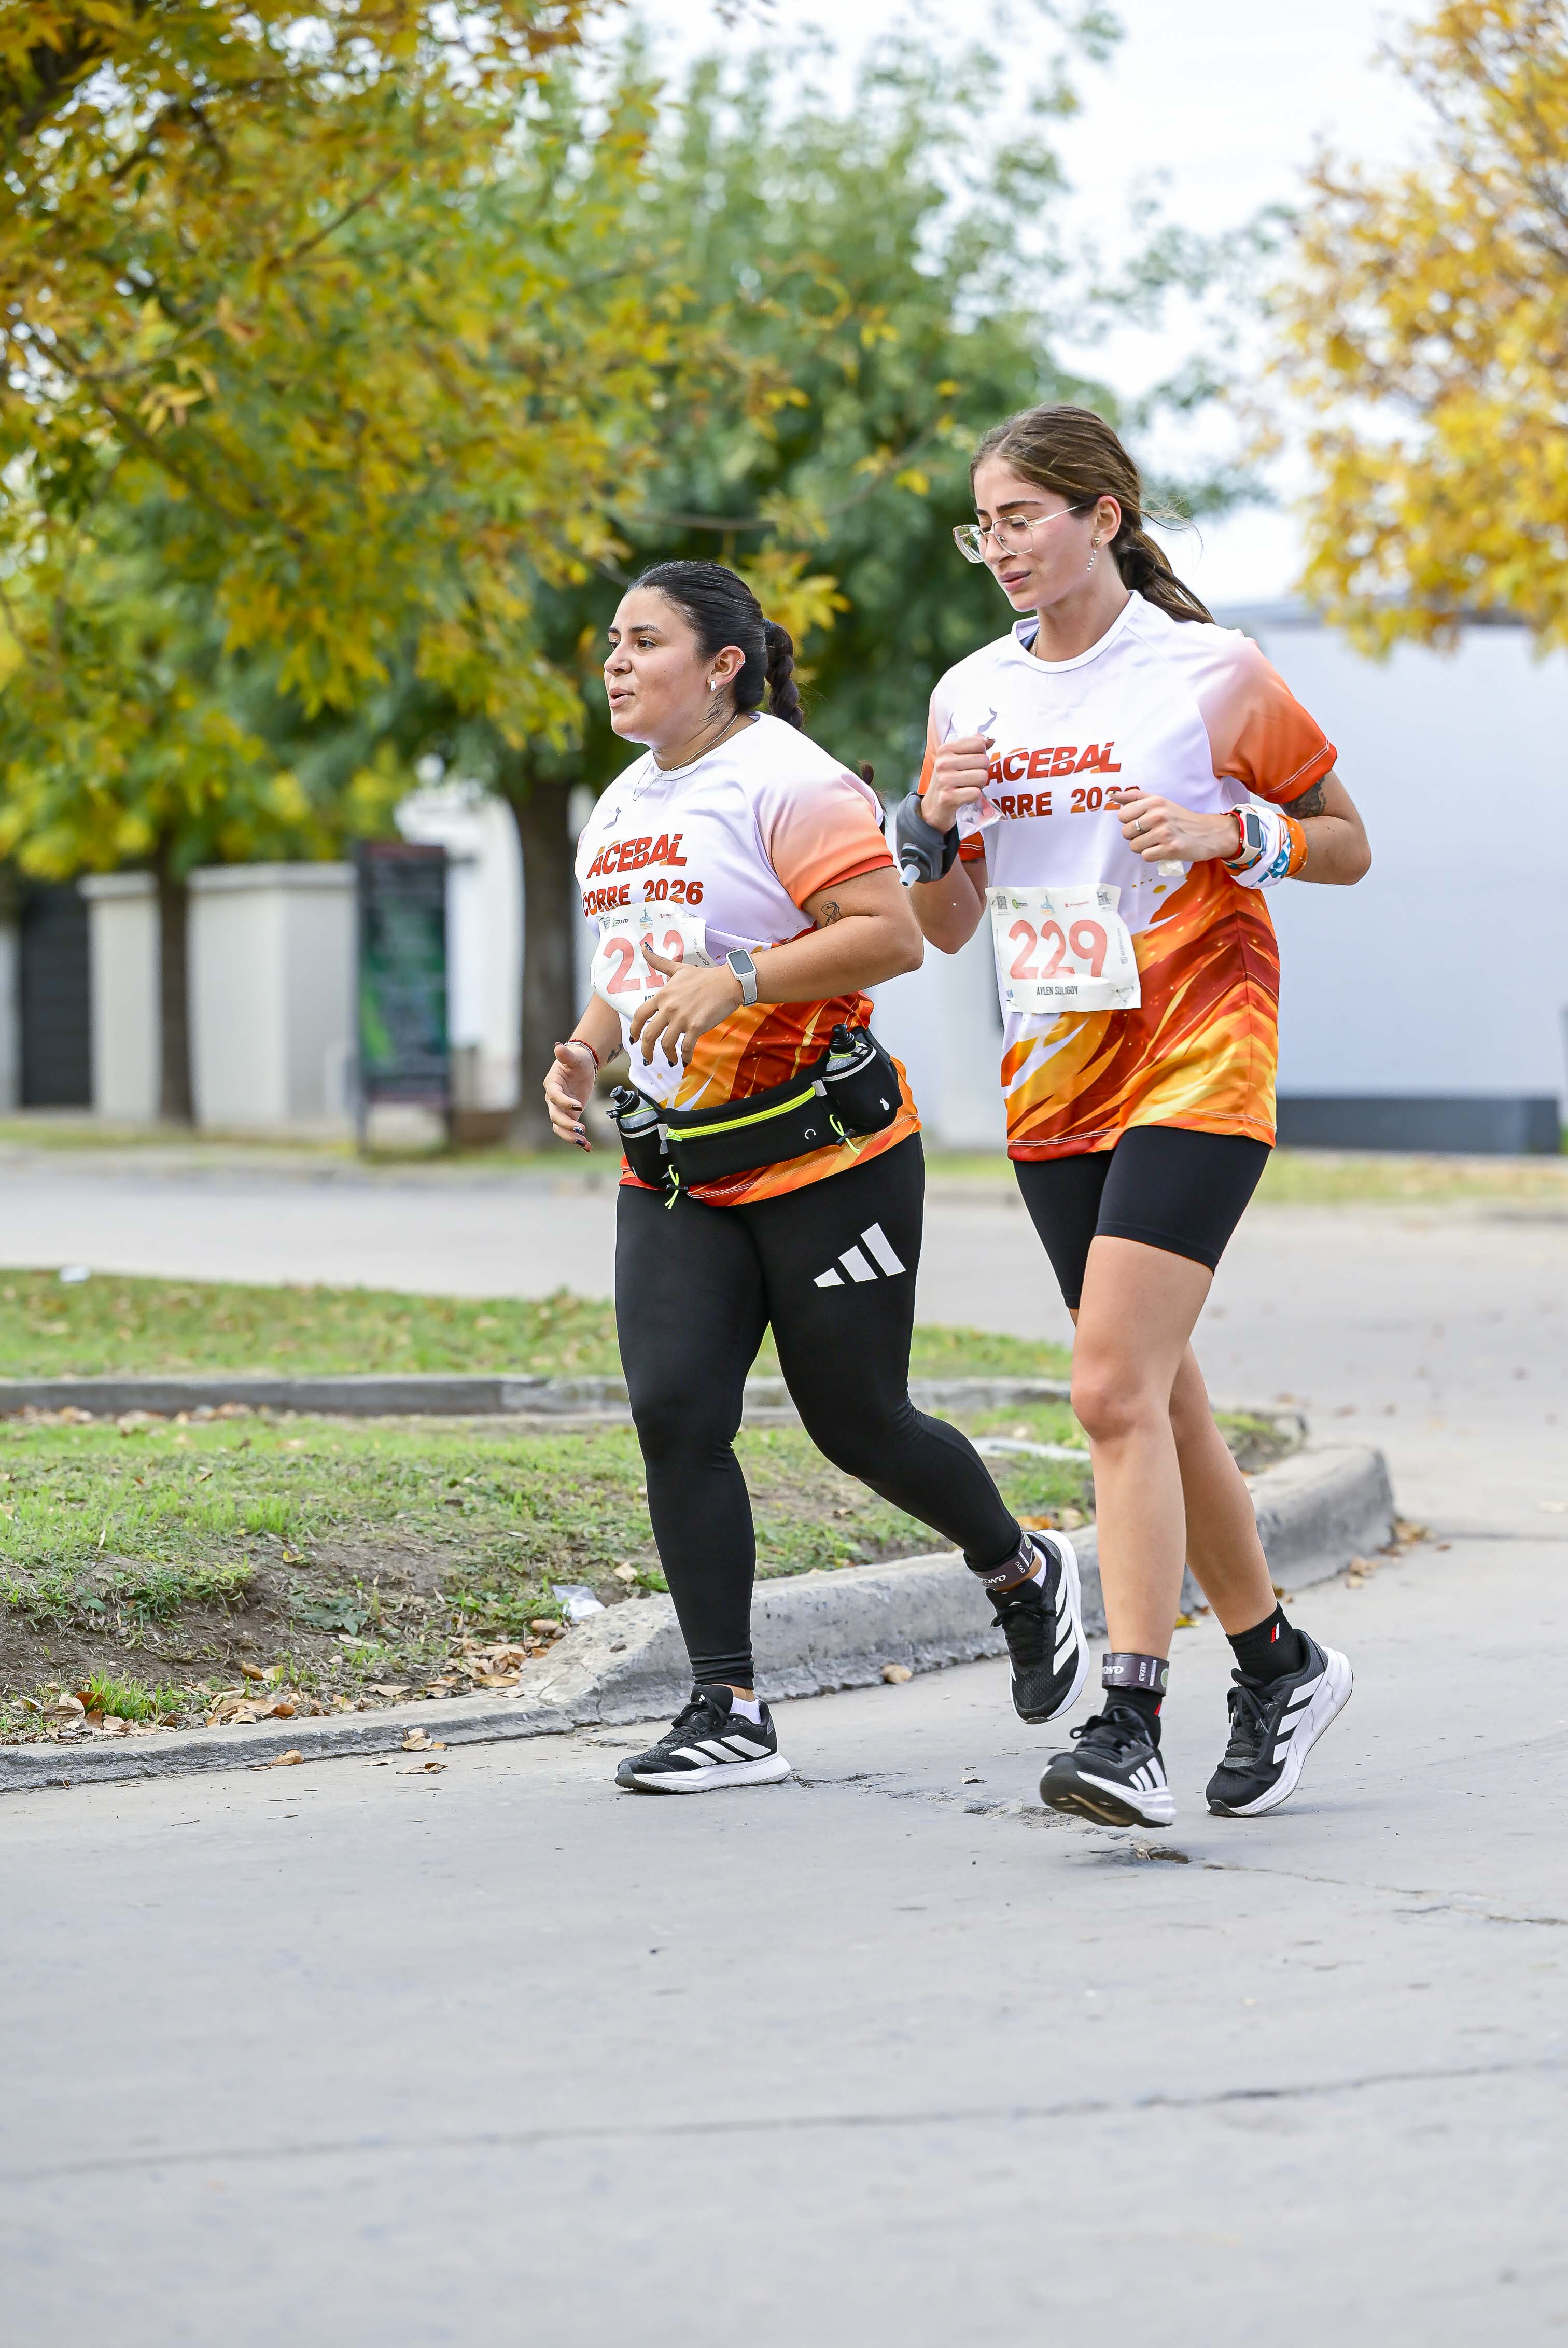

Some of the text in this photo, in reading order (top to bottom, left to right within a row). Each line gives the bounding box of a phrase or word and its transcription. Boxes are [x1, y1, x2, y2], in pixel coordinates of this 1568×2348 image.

[985, 742, 1122, 786] ACEBAL
[991, 786, 1141, 820] RRE 202
[586, 834, 688, 879] ACEBAL
[582, 879, 704, 918] CORRE 2026
[1008, 919, 1108, 980] 229
[1015, 1561, 1026, 1573] CV212
